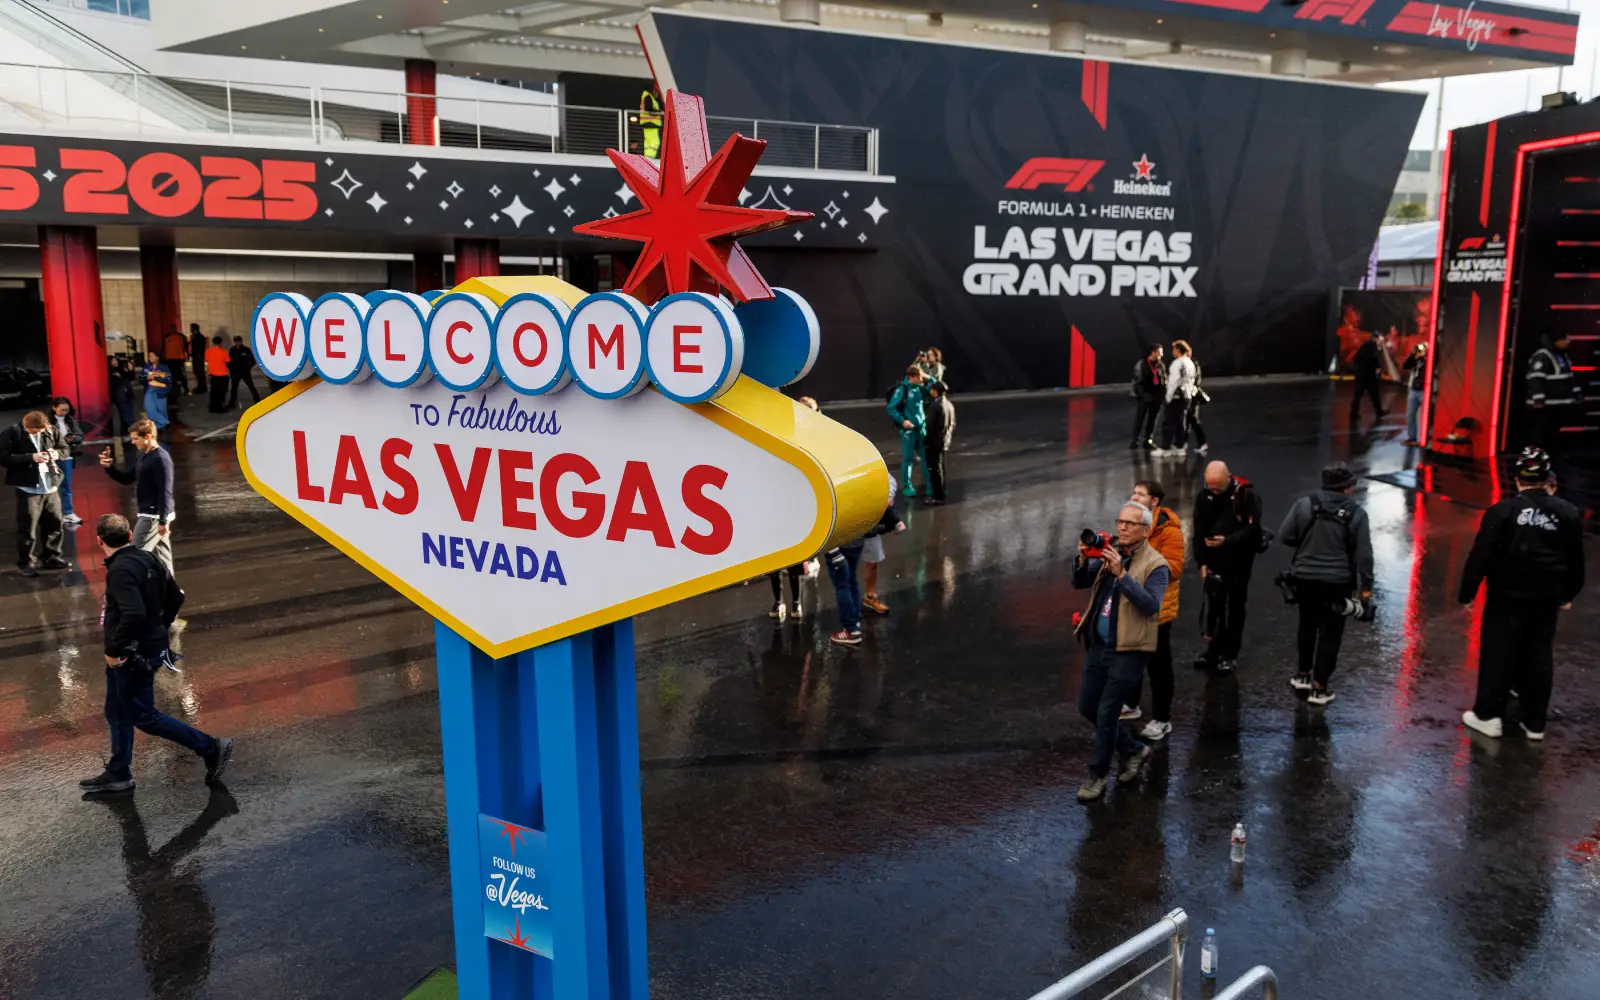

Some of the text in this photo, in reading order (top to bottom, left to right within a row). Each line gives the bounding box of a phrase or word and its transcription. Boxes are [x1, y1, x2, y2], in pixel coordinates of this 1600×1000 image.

[1426, 0, 1496, 51] Las Vegas
[59, 148, 318, 221] 2025
[1004, 157, 1106, 192] F1
[1113, 179, 1172, 196] Heineken
[998, 201, 1175, 221] FORMULA 1 HEINEKEN
[974, 225, 1193, 263] LAS VEGAS
[962, 263, 1199, 298] GRAND PRIX
[261, 317, 703, 374] WELCOME
[410, 393, 562, 436] TO Fabulous
[292, 430, 734, 556] LAS VEGAS
[421, 532, 567, 586] NEVADA
[493, 856, 536, 880] FOLLOW US
[486, 873, 549, 916] @Vegas
